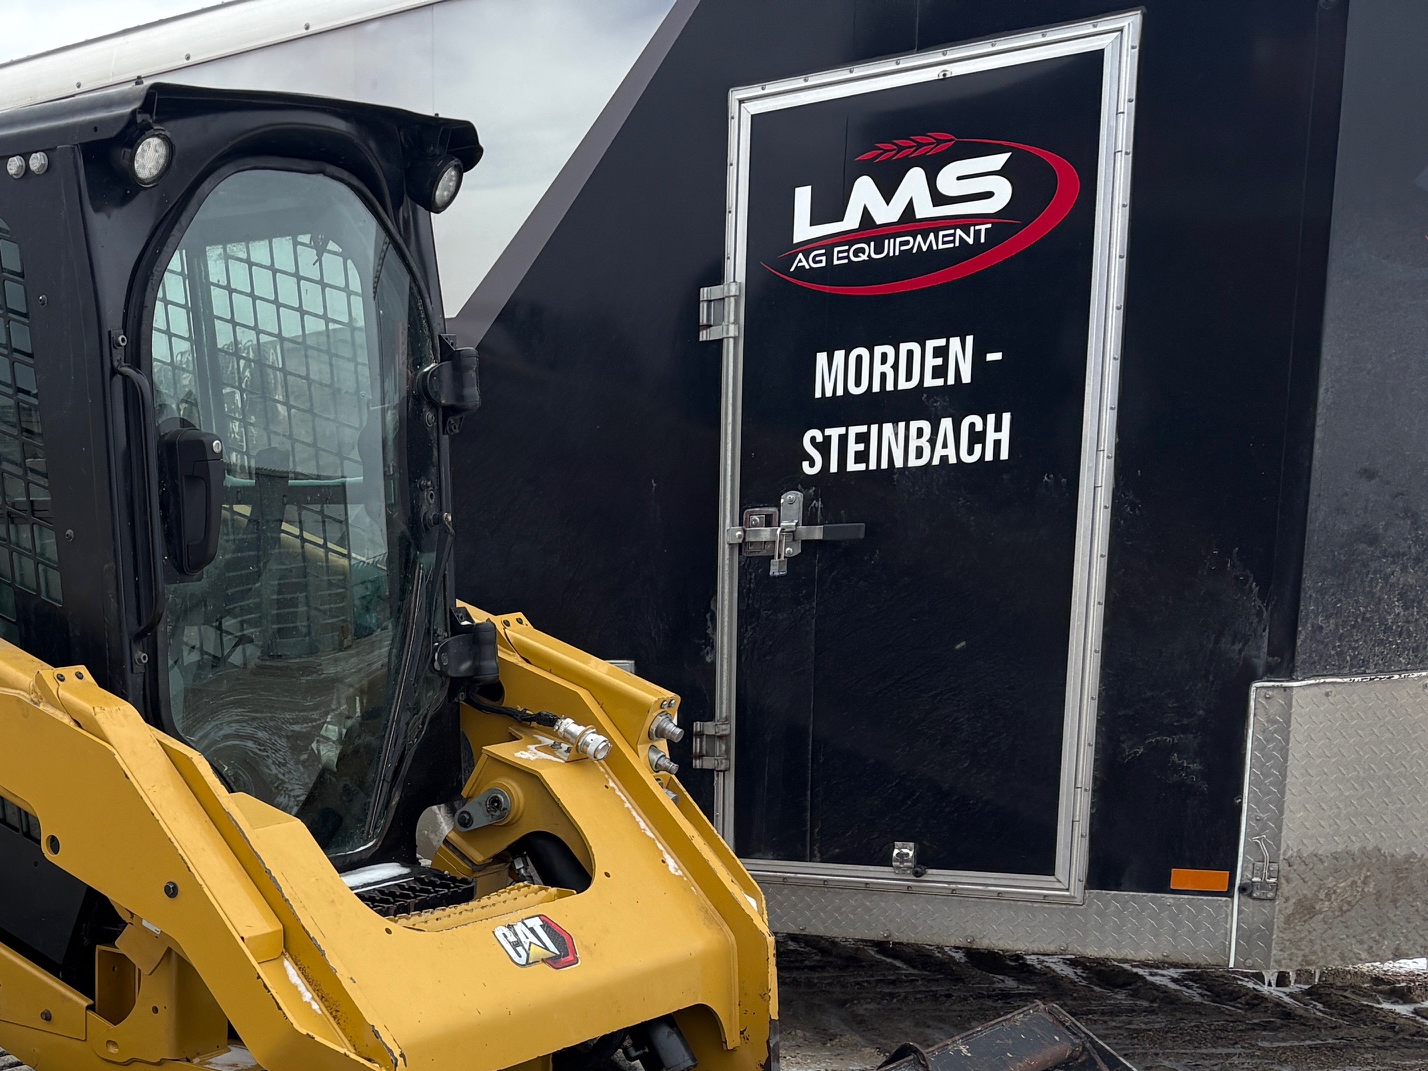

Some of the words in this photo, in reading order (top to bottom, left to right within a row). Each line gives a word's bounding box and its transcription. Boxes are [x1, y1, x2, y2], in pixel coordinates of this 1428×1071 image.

[792, 151, 1013, 244] LMS
[789, 248, 827, 272] AG
[832, 223, 993, 266] EQUIPMENT
[814, 334, 974, 399] MORDEN
[801, 411, 1012, 476] STEINBACH
[494, 916, 561, 965] CAT
